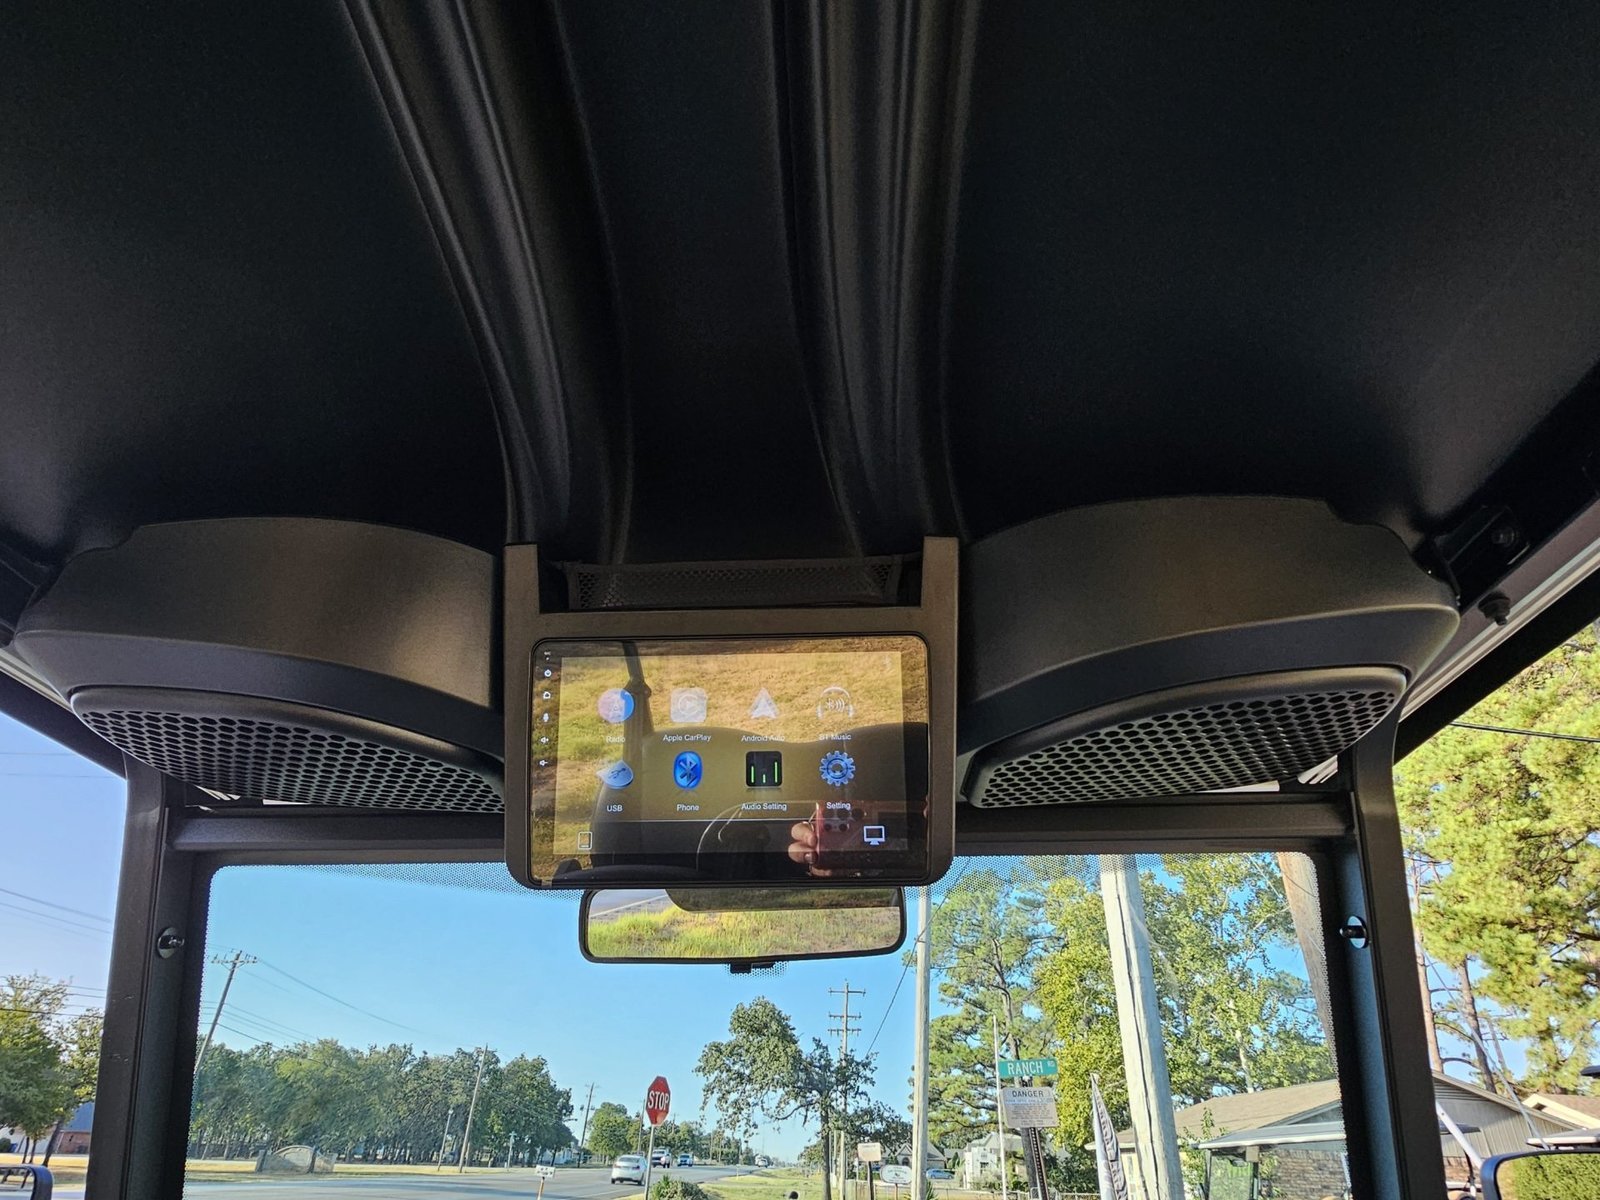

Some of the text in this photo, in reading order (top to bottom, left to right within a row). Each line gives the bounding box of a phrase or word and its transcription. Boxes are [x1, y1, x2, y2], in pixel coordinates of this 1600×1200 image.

[662, 733, 712, 743] Apple CarPlay
[741, 734, 768, 743] Android
[831, 733, 852, 741] Music
[606, 804, 623, 812] USB
[676, 803, 700, 811] Phone
[741, 803, 788, 812] Audio Setting
[826, 801, 852, 811] Setting
[1007, 1061, 1044, 1075] RANCH
[1011, 1090, 1044, 1098] DANGER
[648, 1090, 669, 1110] STOP
